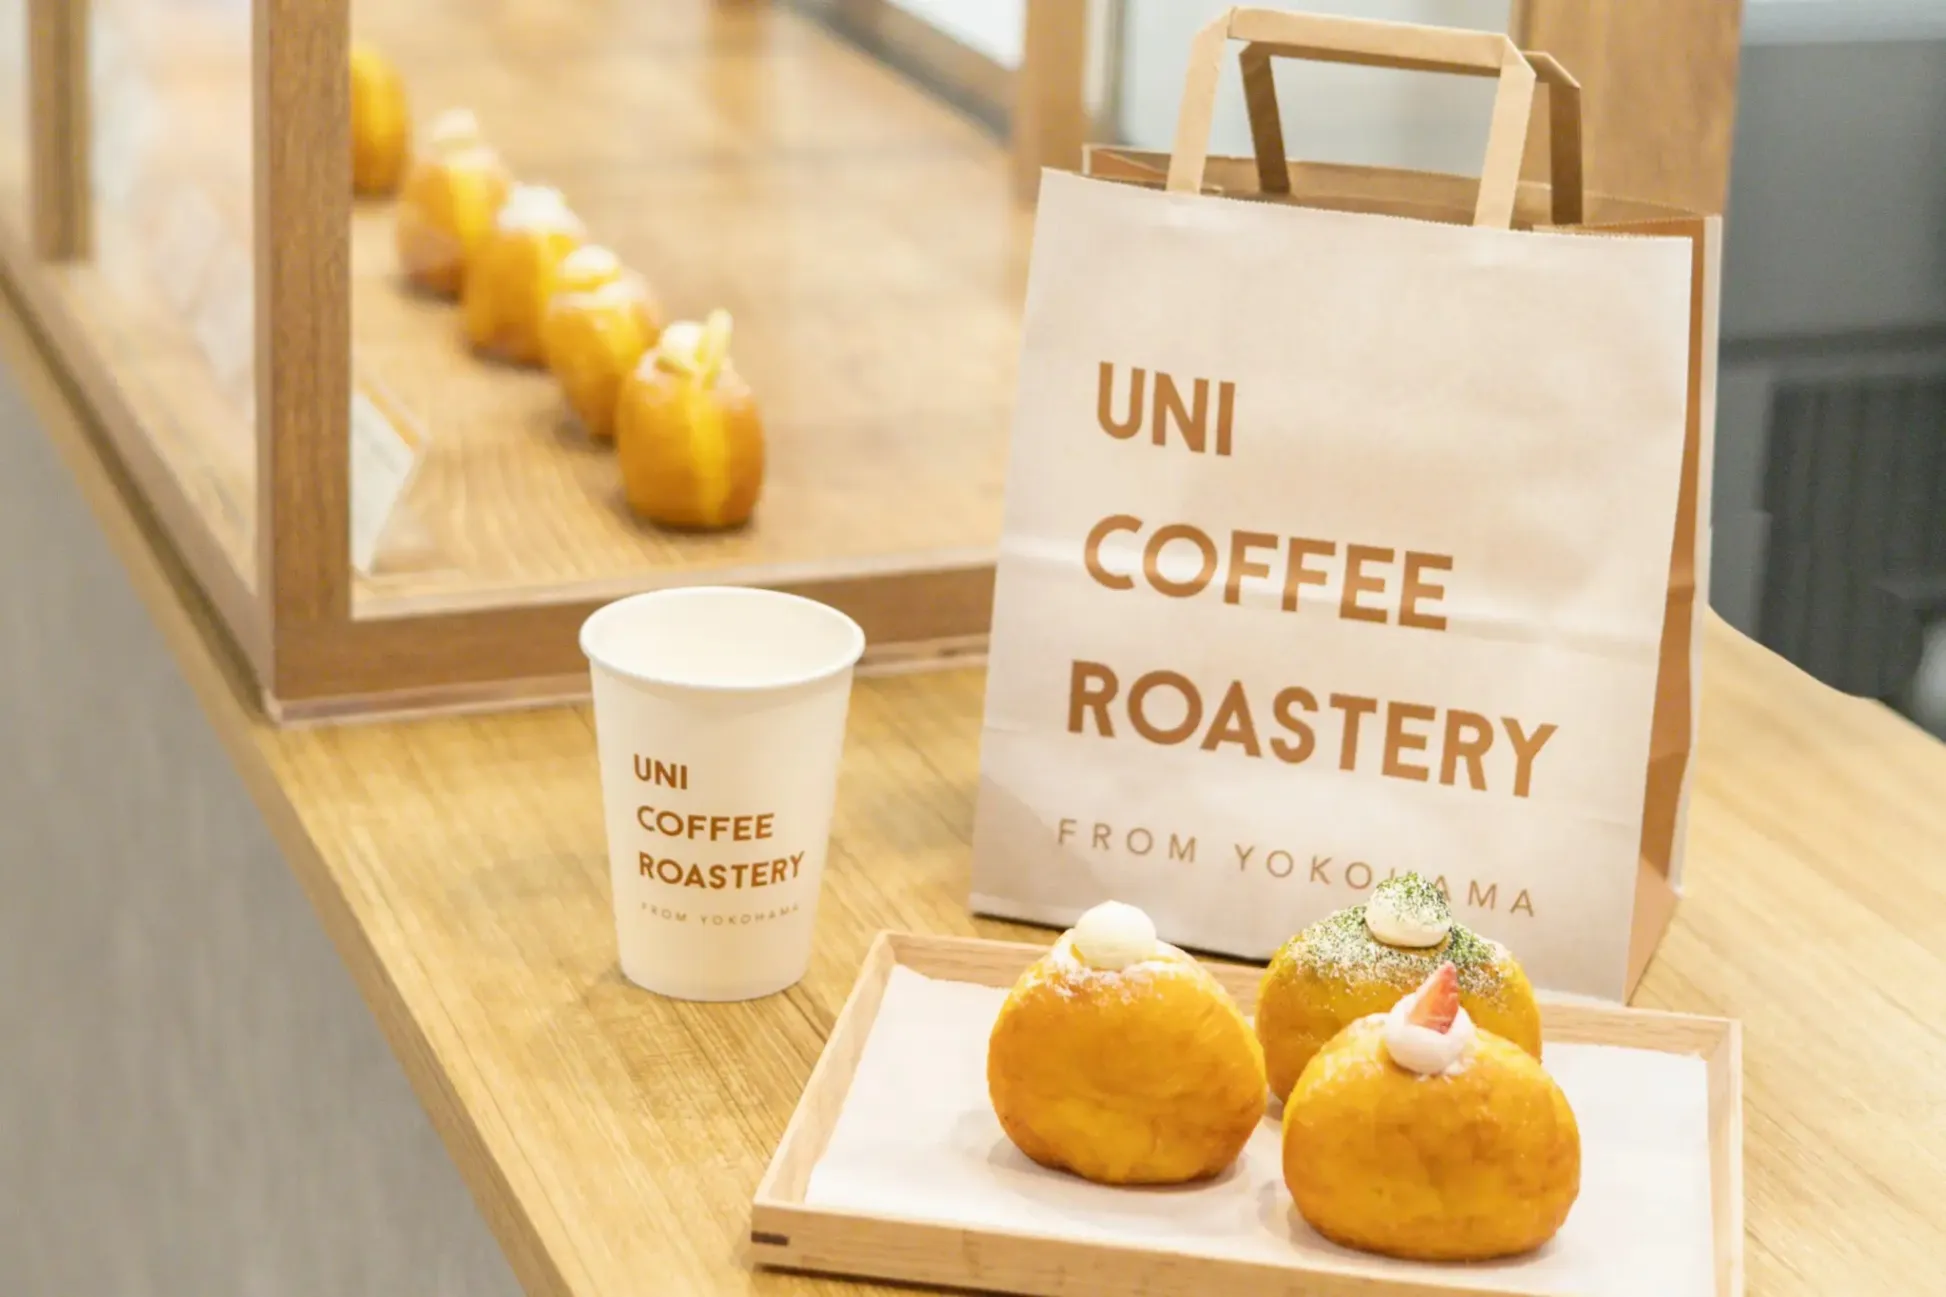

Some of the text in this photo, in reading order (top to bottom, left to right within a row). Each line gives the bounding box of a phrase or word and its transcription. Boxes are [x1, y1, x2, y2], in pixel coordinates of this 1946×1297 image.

[1096, 361, 1236, 457] UNI
[1084, 514, 1454, 632] COFFEE
[1067, 659, 1559, 799] ROASTERY
[634, 753, 688, 790] UNI
[637, 805, 775, 841] COFFEE
[639, 851, 805, 889] ROASTERY
[1057, 818, 1535, 917] FROM YOKOAMA
[640, 902, 799, 926] FROM YOKOHAMA
